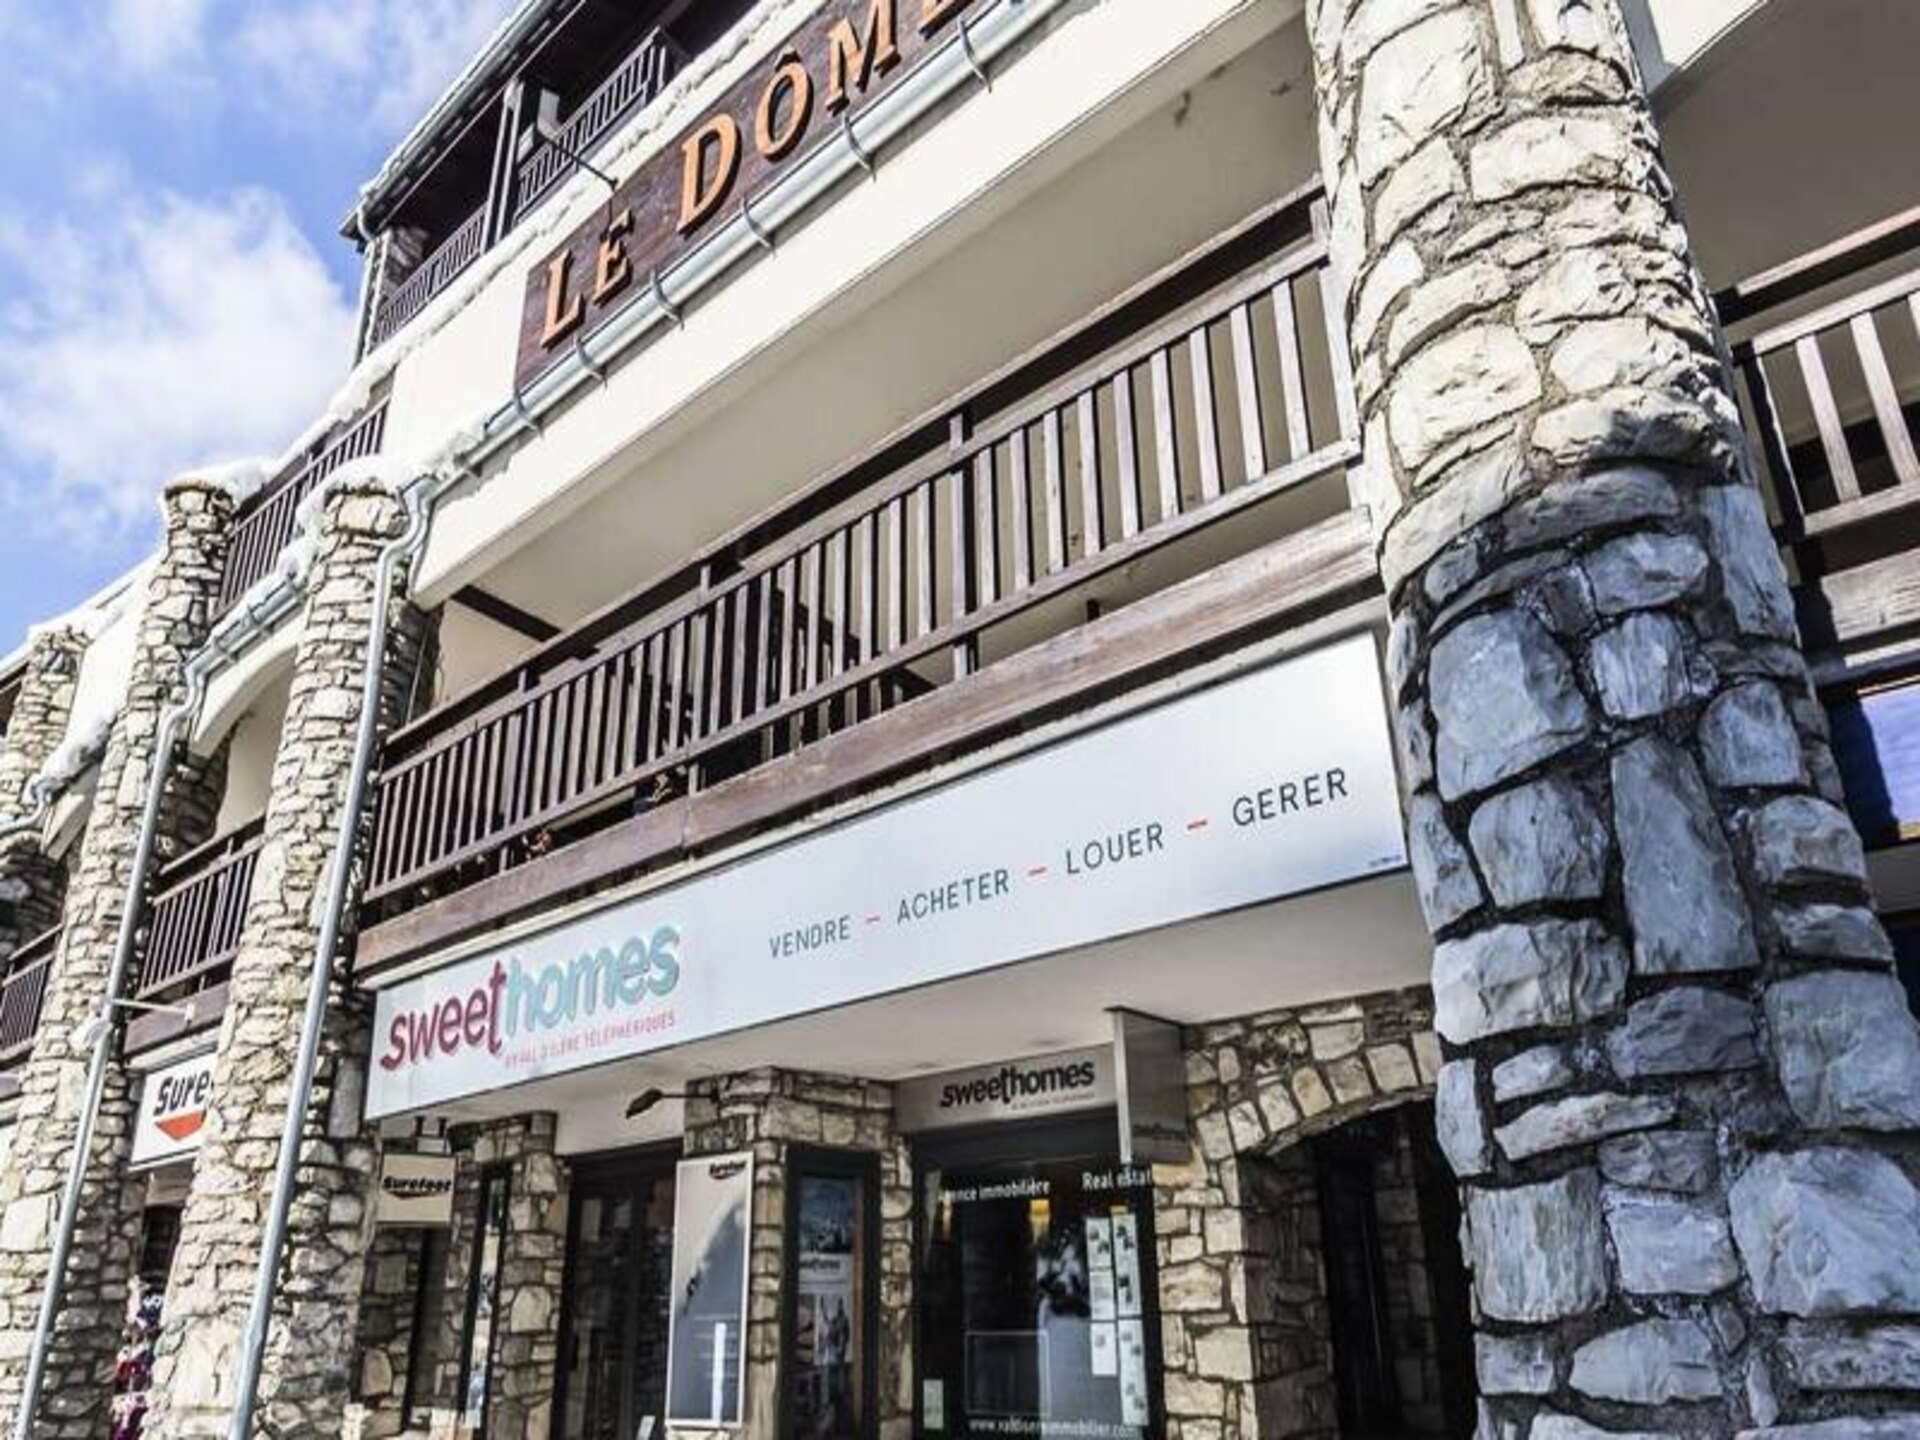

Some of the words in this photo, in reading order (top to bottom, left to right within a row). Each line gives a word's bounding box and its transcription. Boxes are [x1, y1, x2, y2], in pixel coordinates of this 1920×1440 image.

[540, 208, 634, 350] LE
[768, 914, 851, 959] VENDRE
[897, 868, 1010, 925] ACHETER
[1065, 823, 1165, 876] LOUER
[1231, 767, 1349, 828] GERER
[152, 1069, 215, 1117] Sure
[939, 1060, 1096, 1109] sweethomes
[1081, 1170, 1114, 1192] Real
